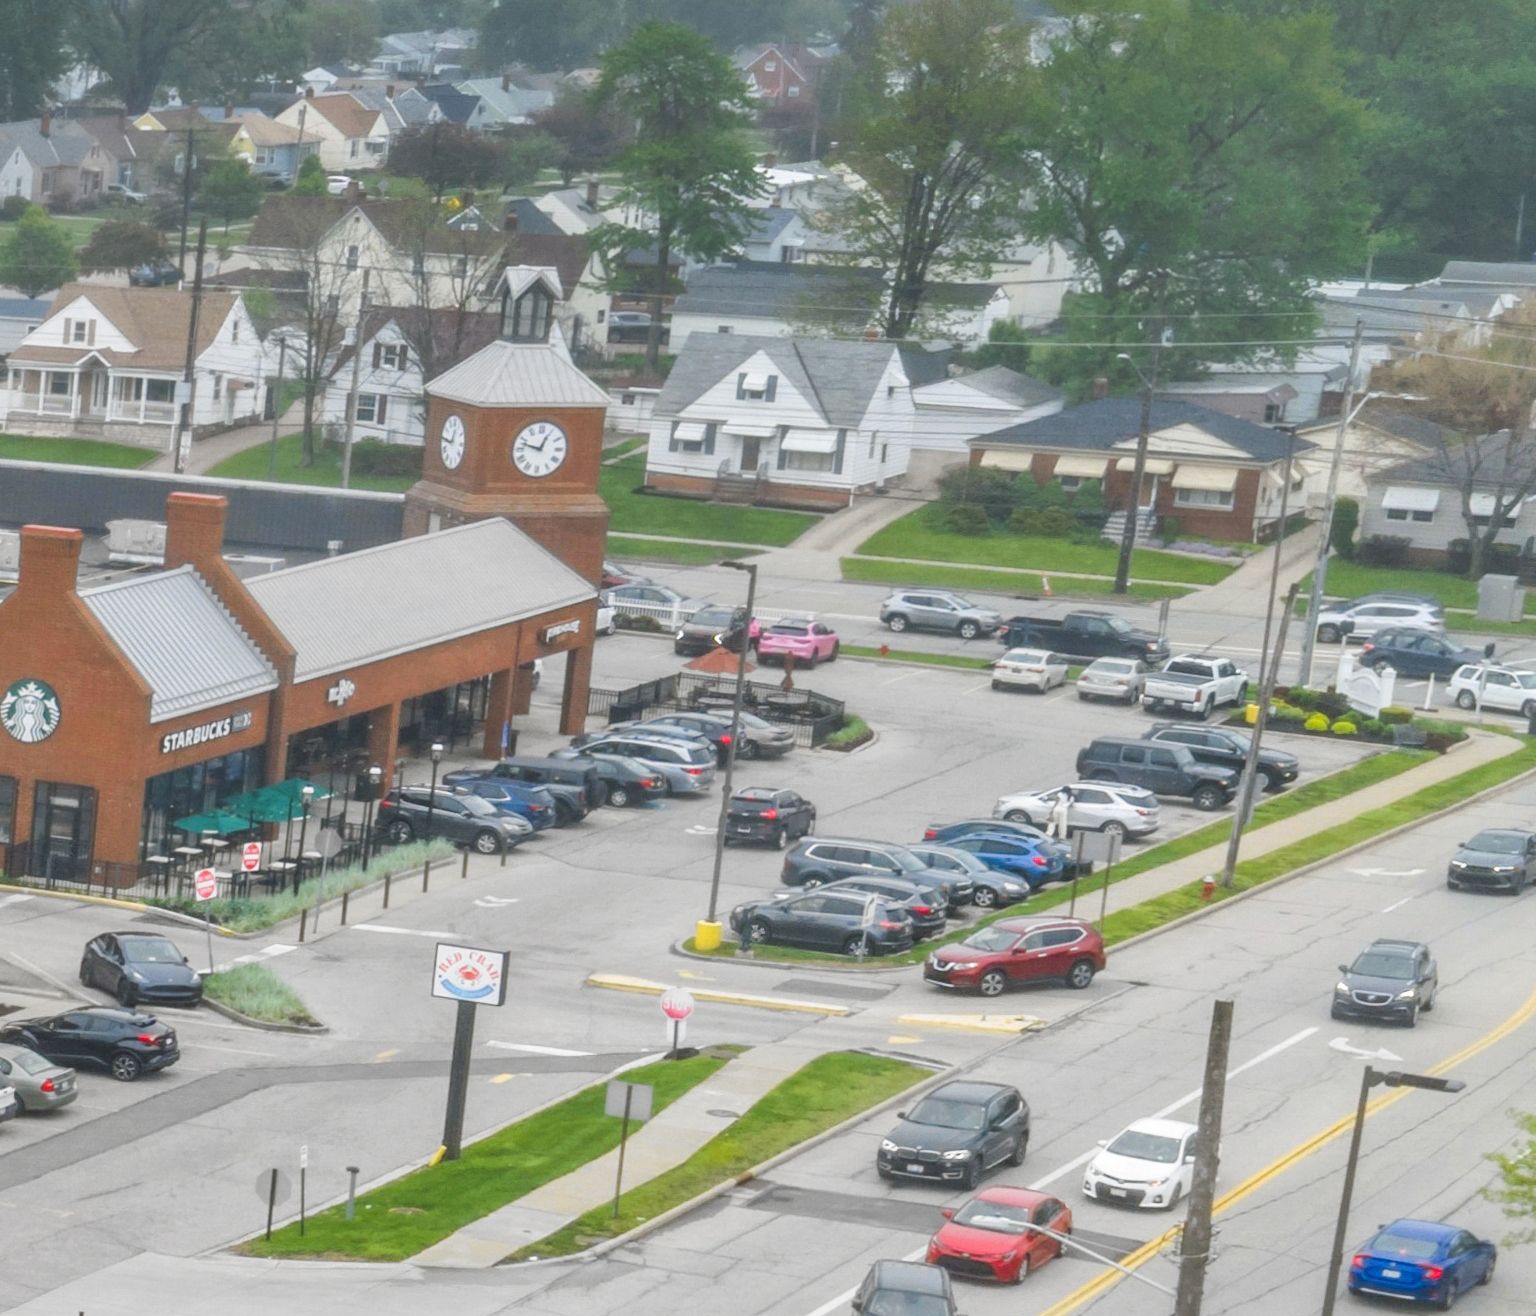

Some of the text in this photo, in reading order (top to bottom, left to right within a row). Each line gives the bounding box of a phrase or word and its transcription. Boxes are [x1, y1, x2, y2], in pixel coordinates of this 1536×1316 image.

[163, 718, 231, 753] STARBUCKS
[439, 952, 499, 980] RED CRAB
